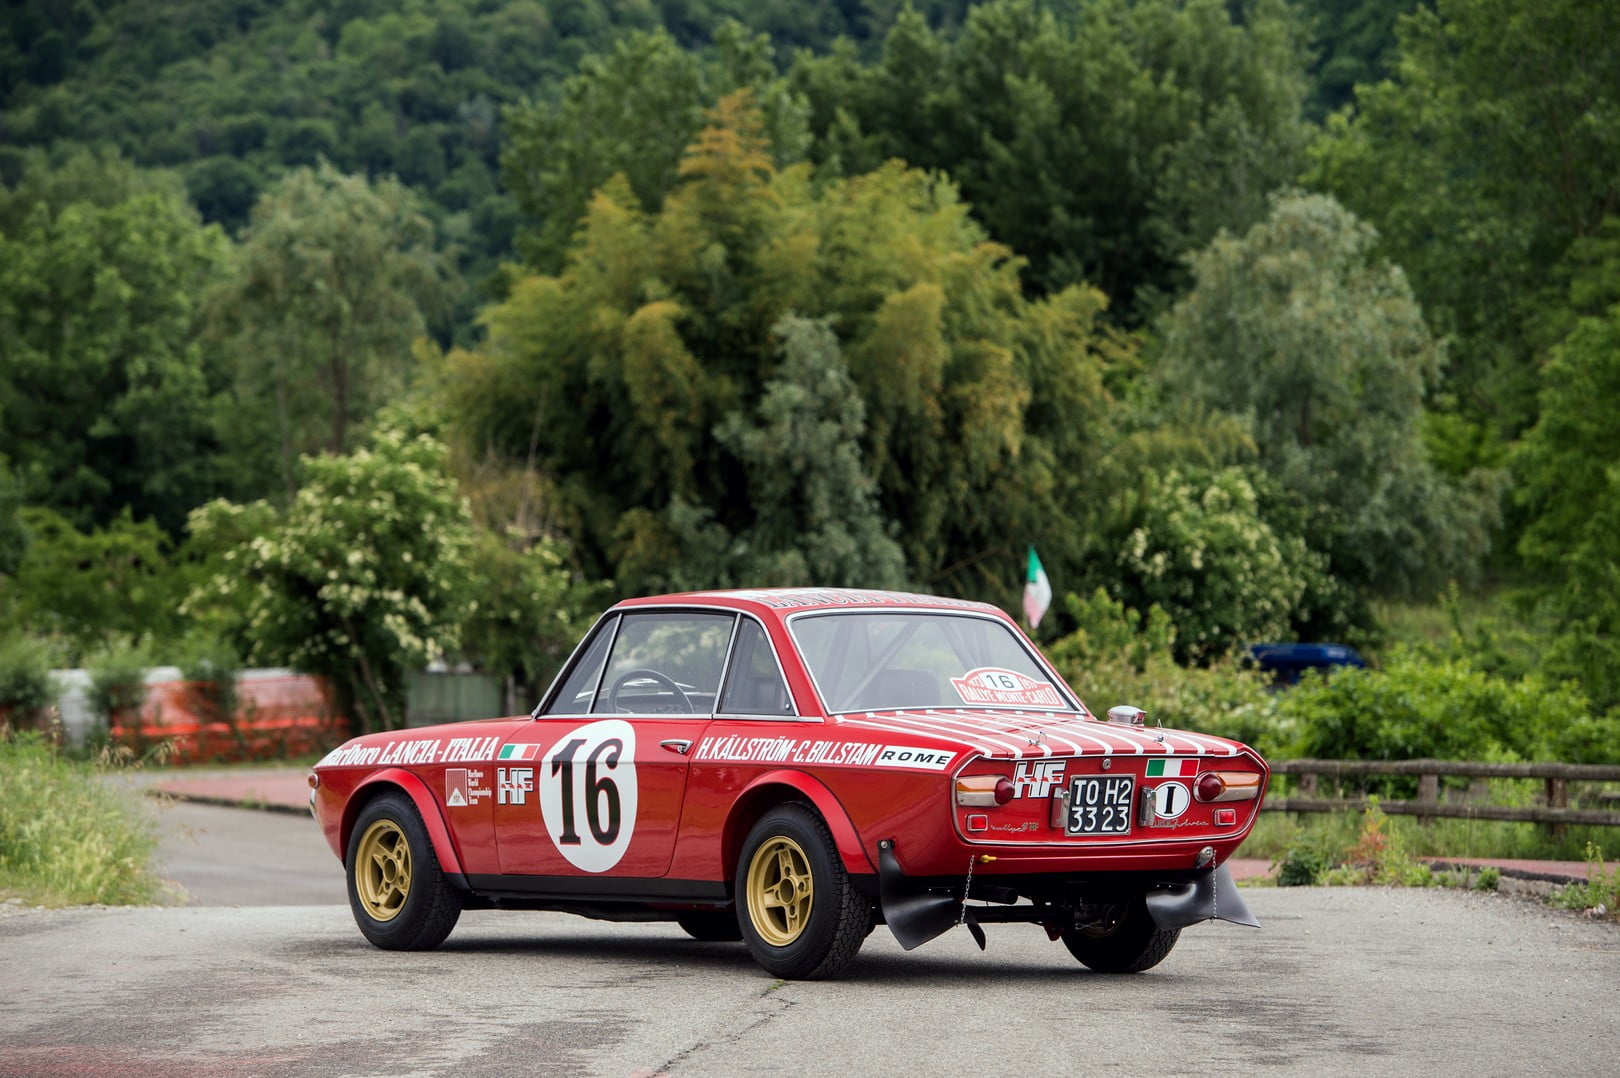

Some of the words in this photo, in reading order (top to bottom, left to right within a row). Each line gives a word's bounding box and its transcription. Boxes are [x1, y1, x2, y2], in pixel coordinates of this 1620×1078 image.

[959, 685, 997, 702] RALLYE
[986, 675, 1014, 689] 16
[378, 737, 500, 763] LANCIA-ITALIA
[881, 750, 951, 765] ROME
[497, 767, 534, 805] HF
[551, 738, 623, 846] 16
[1013, 760, 1067, 799] HF
[1074, 780, 1099, 805] TO
[1104, 779, 1132, 805] H2
